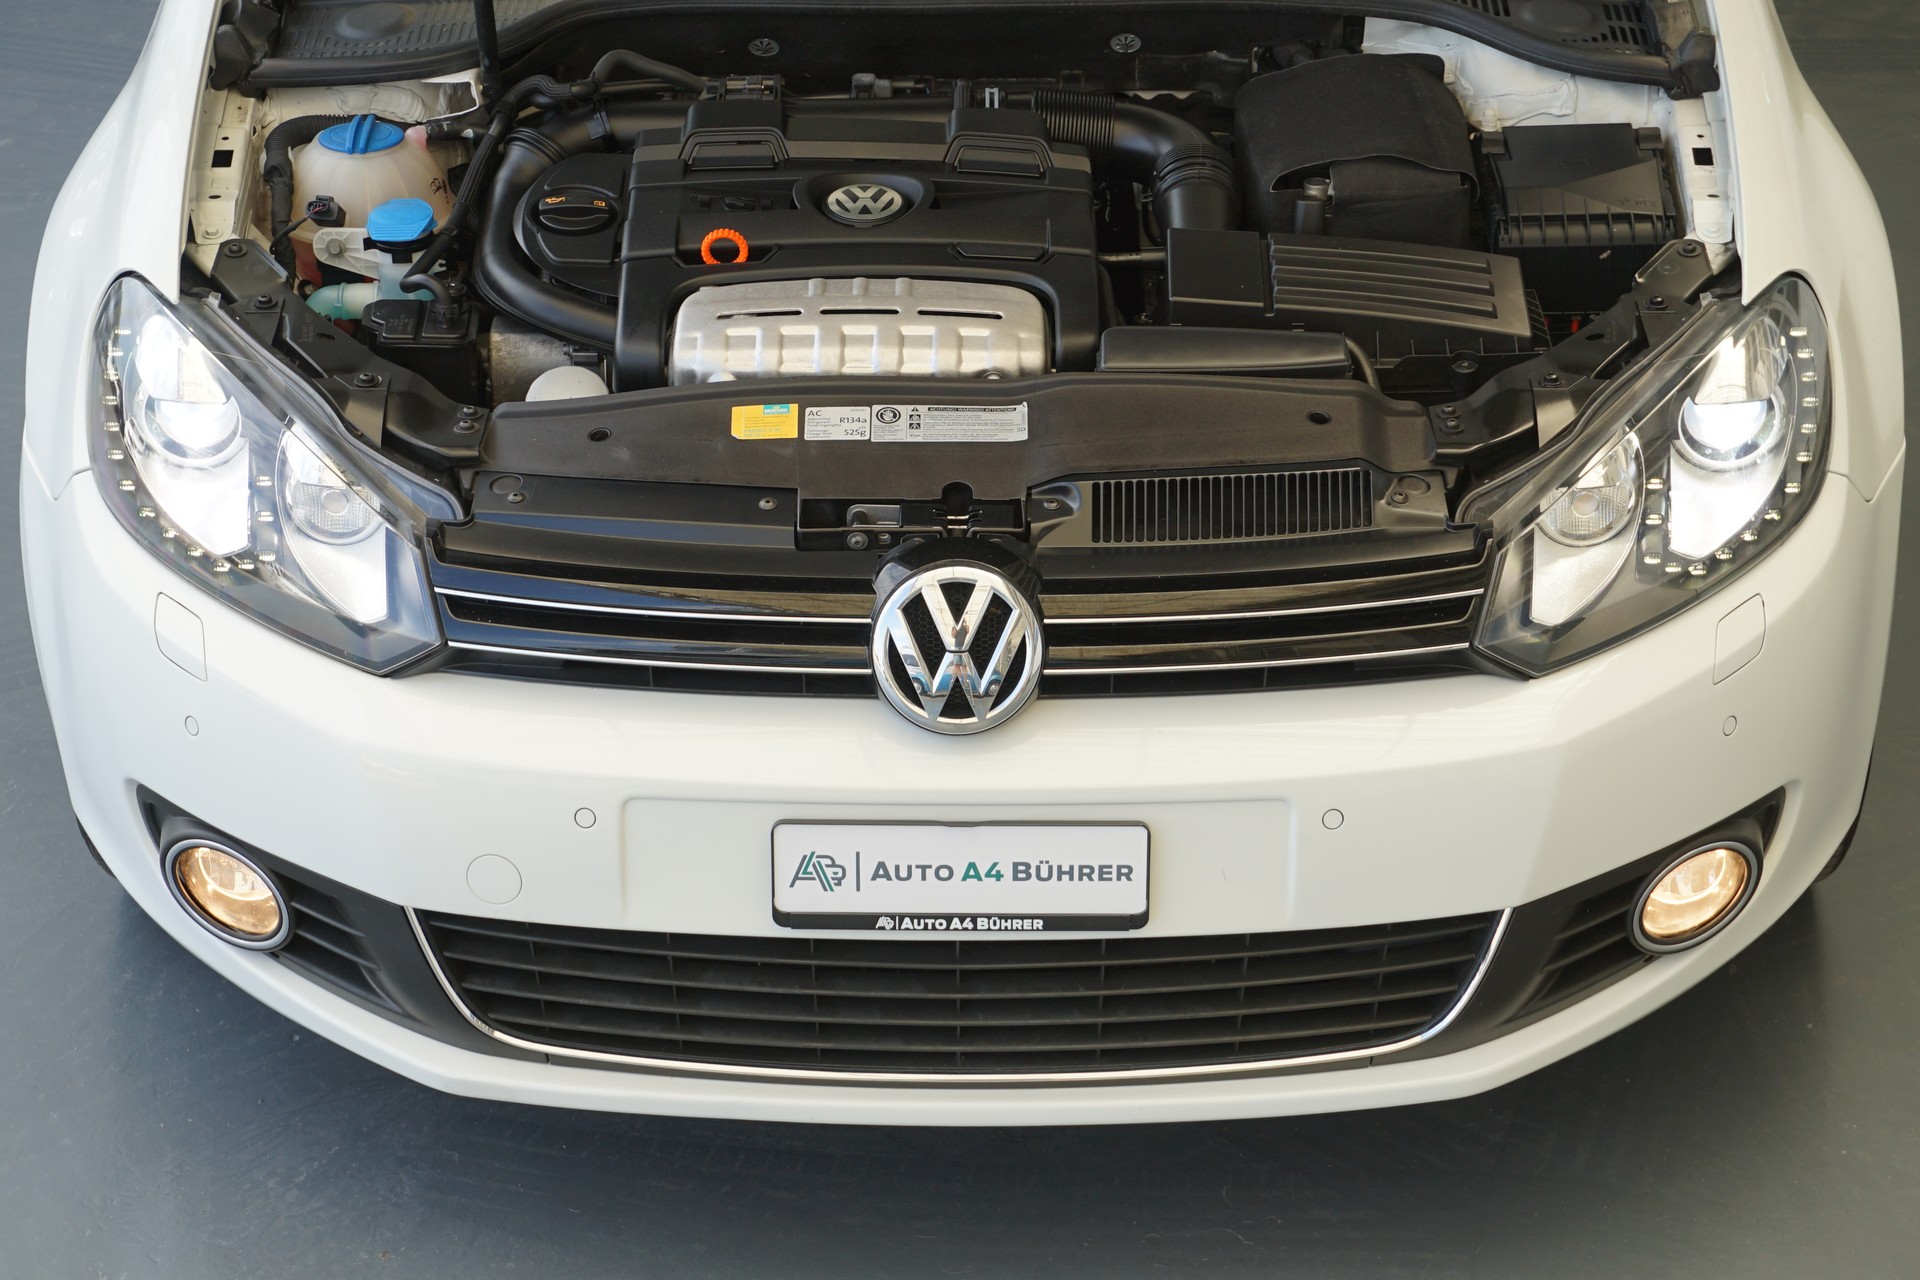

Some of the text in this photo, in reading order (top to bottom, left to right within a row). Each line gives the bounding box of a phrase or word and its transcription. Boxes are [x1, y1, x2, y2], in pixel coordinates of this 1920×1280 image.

[829, 185, 901, 219] VW
[844, 429, 867, 438] 525g
[875, 566, 1039, 733] VW
[960, 861, 1004, 881] A4
[1012, 860, 1134, 882] BÜHRER
[949, 916, 974, 930] A4
[976, 915, 1044, 930] BÜHRER
